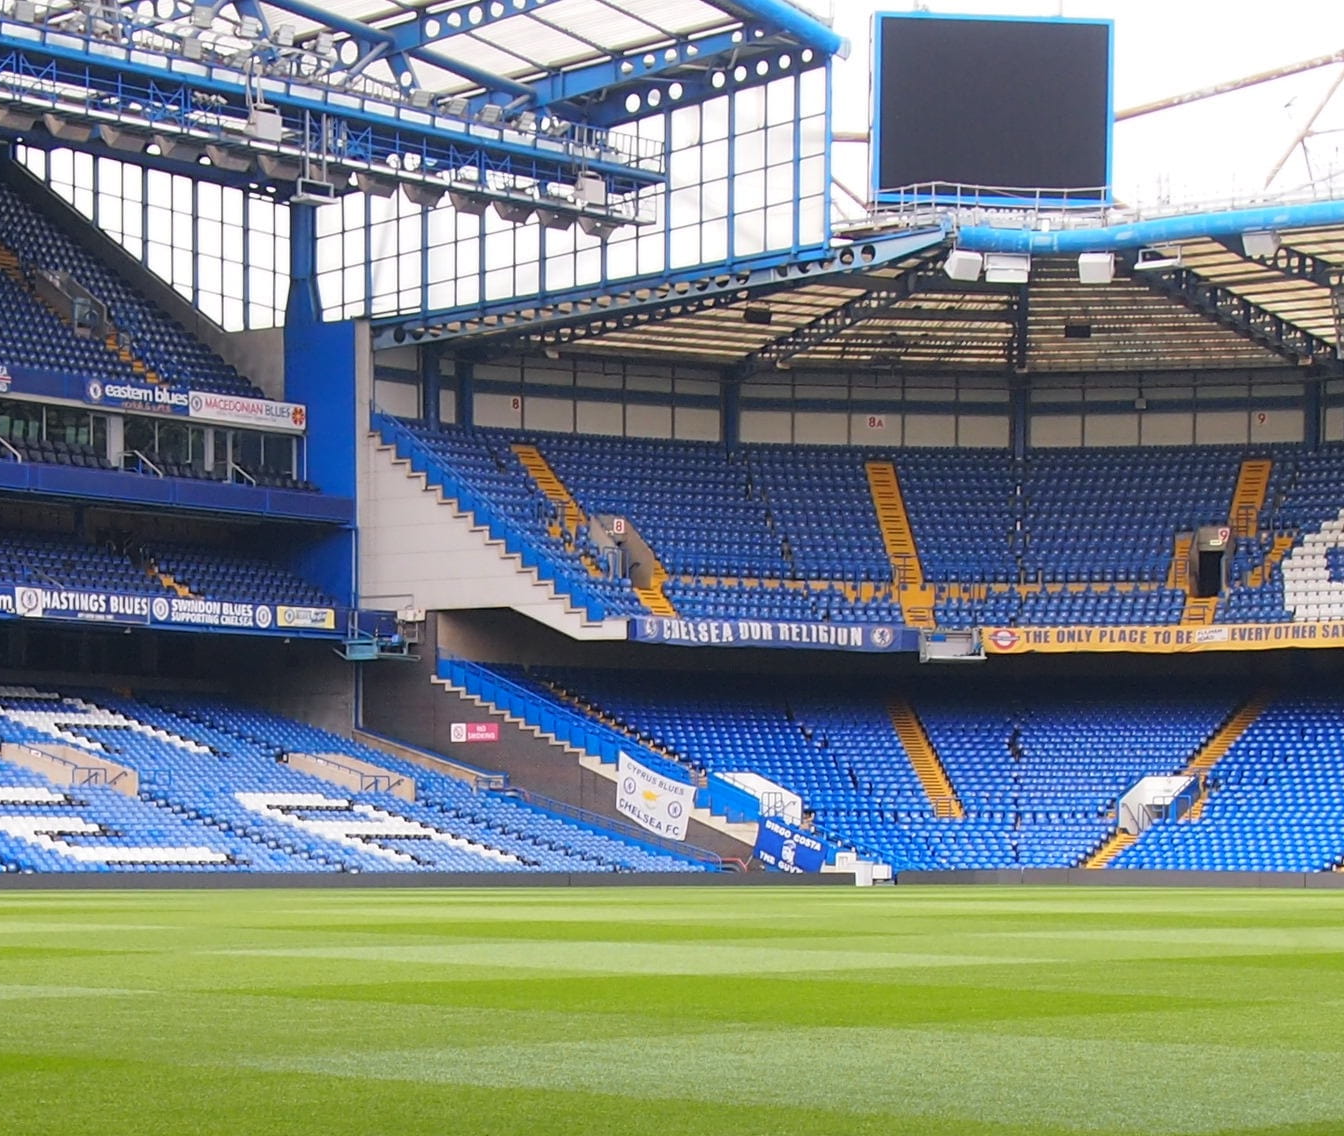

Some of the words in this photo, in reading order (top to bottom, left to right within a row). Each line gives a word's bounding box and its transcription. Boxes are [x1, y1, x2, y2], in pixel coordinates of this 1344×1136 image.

[105, 384, 153, 402] eastern
[155, 387, 188, 407] blues
[512, 398, 520, 410] 8
[205, 398, 264, 416] MACEDONIAN
[264, 405, 290, 419] BLUES
[868, 416, 884, 428] 8A
[1258, 413, 1266, 424] 9
[615, 521, 622, 532] 8
[1220, 530, 1228, 541] 9
[42, 590, 106, 613] HASTINGS
[110, 595, 148, 616] BLUES
[171, 599, 221, 615] SWINDON
[223, 602, 253, 617] BLUES
[171, 611, 219, 625] SUPPORTING
[220, 614, 254, 627] CHELSEA
[662, 620, 734, 643] CHELSEA
[1024, 630, 1050, 644] THE
[1056, 629, 1093, 643] ONLY
[1099, 630, 1147, 644] PLACE
[1154, 630, 1171, 644] TO
[1176, 630, 1193, 645] BE
[1231, 626, 1271, 641] EVERY
[1273, 624, 1317, 640] OTHER
[627, 762, 657, 785] CYPRUS
[658, 780, 684, 796] BLUES
[619, 798, 662, 831] CHELSEA
[665, 824, 679, 836] FC
[765, 819, 791, 839] DIEGO
[793, 834, 821, 851] COSTA
[759, 850, 775, 865] THE
